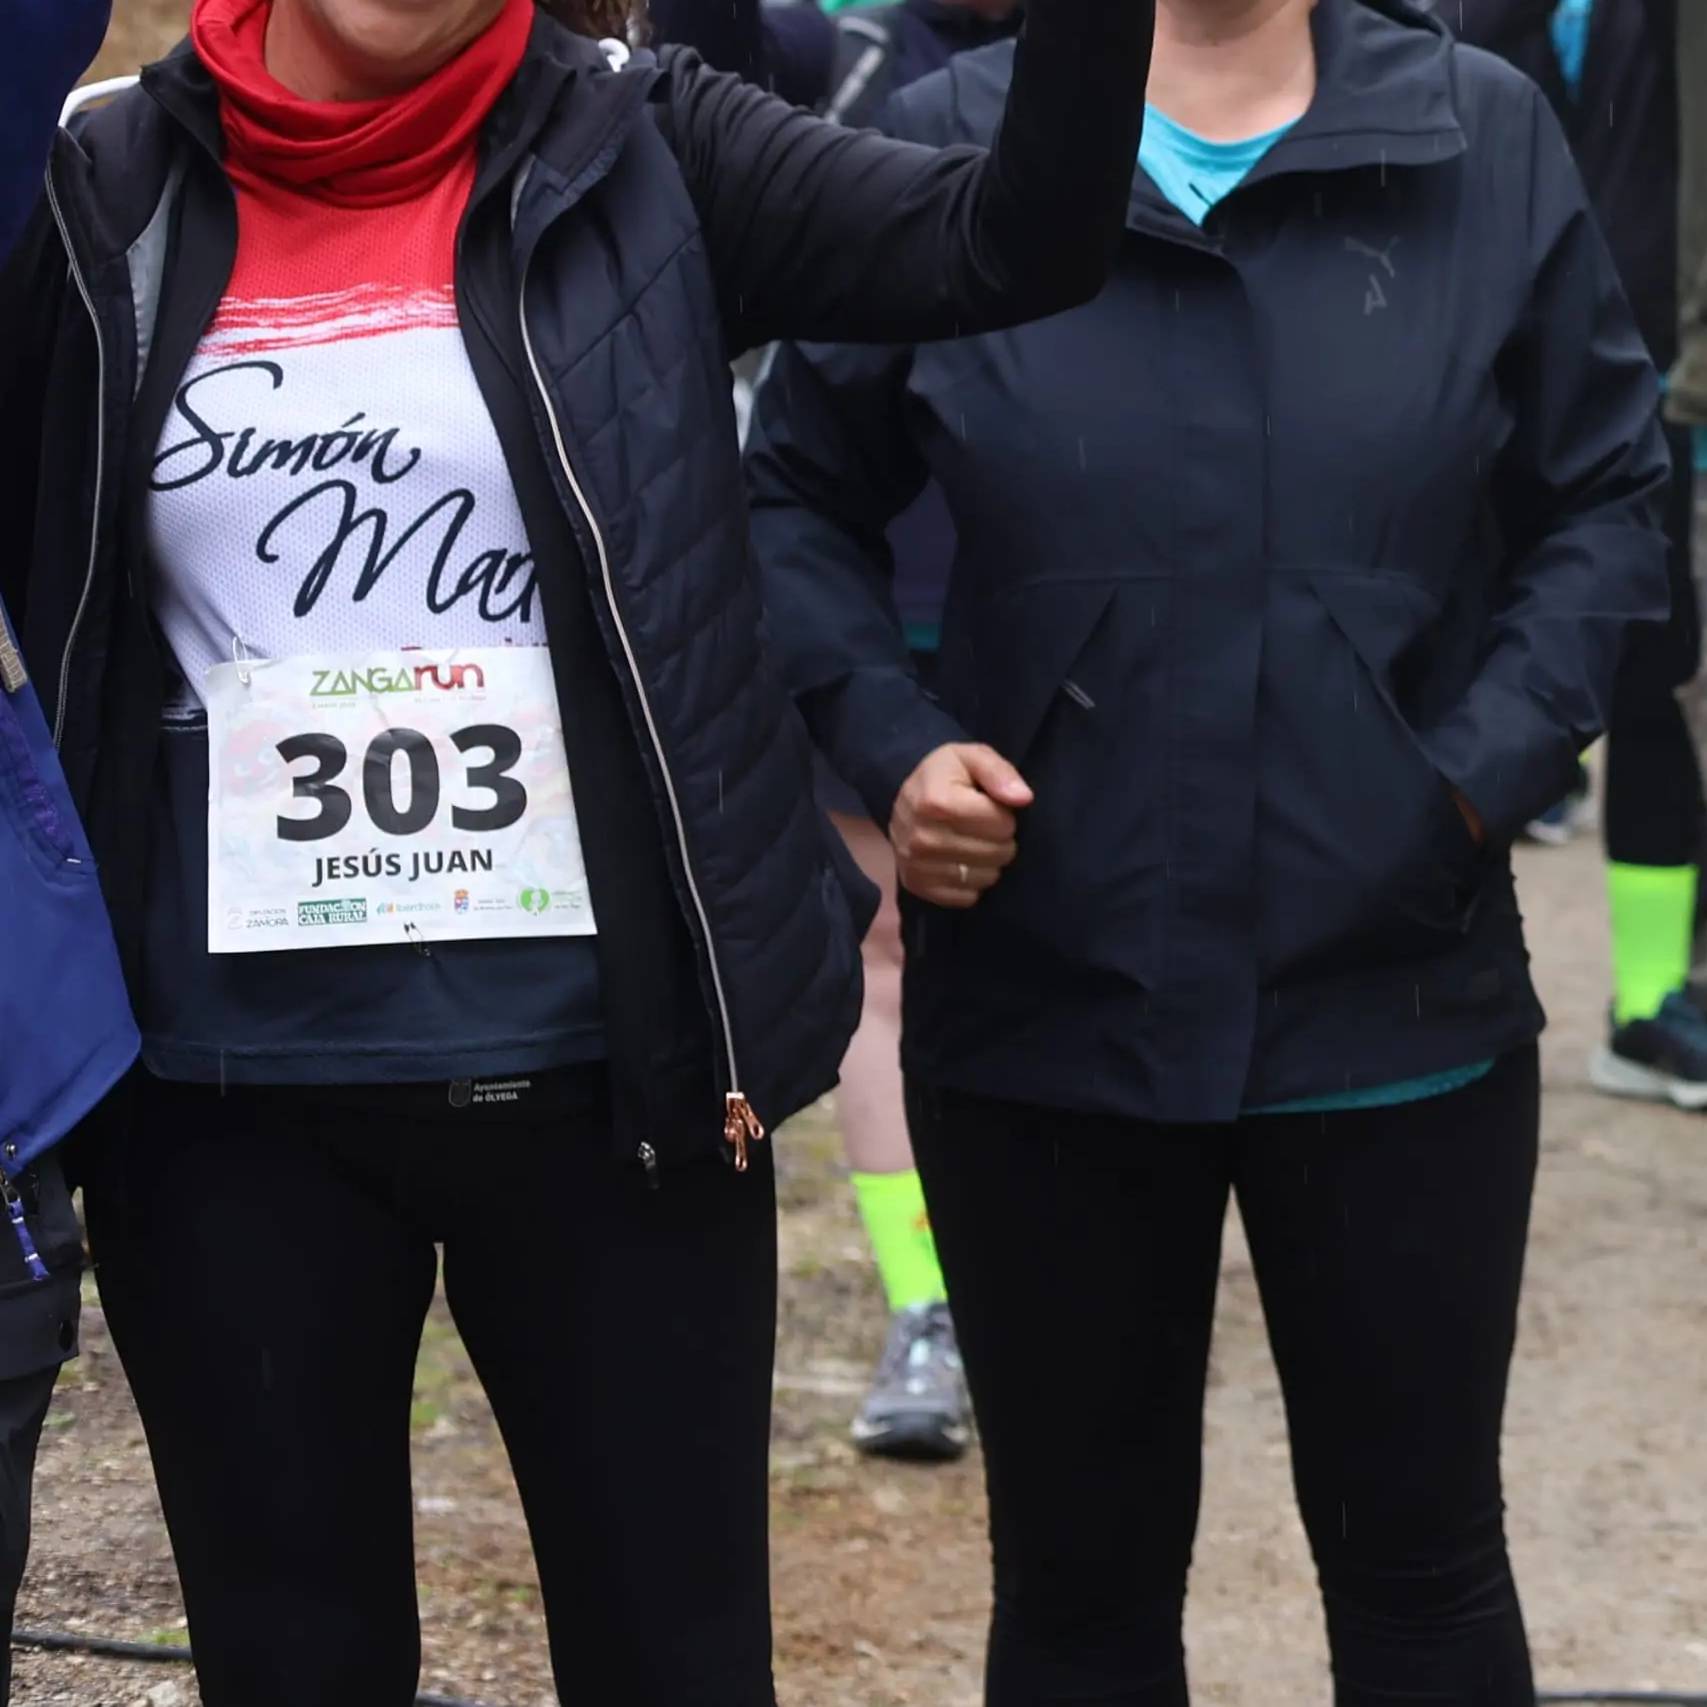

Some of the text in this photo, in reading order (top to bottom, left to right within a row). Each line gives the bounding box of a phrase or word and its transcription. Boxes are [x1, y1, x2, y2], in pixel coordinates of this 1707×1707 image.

[148, 360, 422, 492] Simón
[275, 723, 527, 842] 303
[311, 848, 493, 888] JESÚS JUAN
